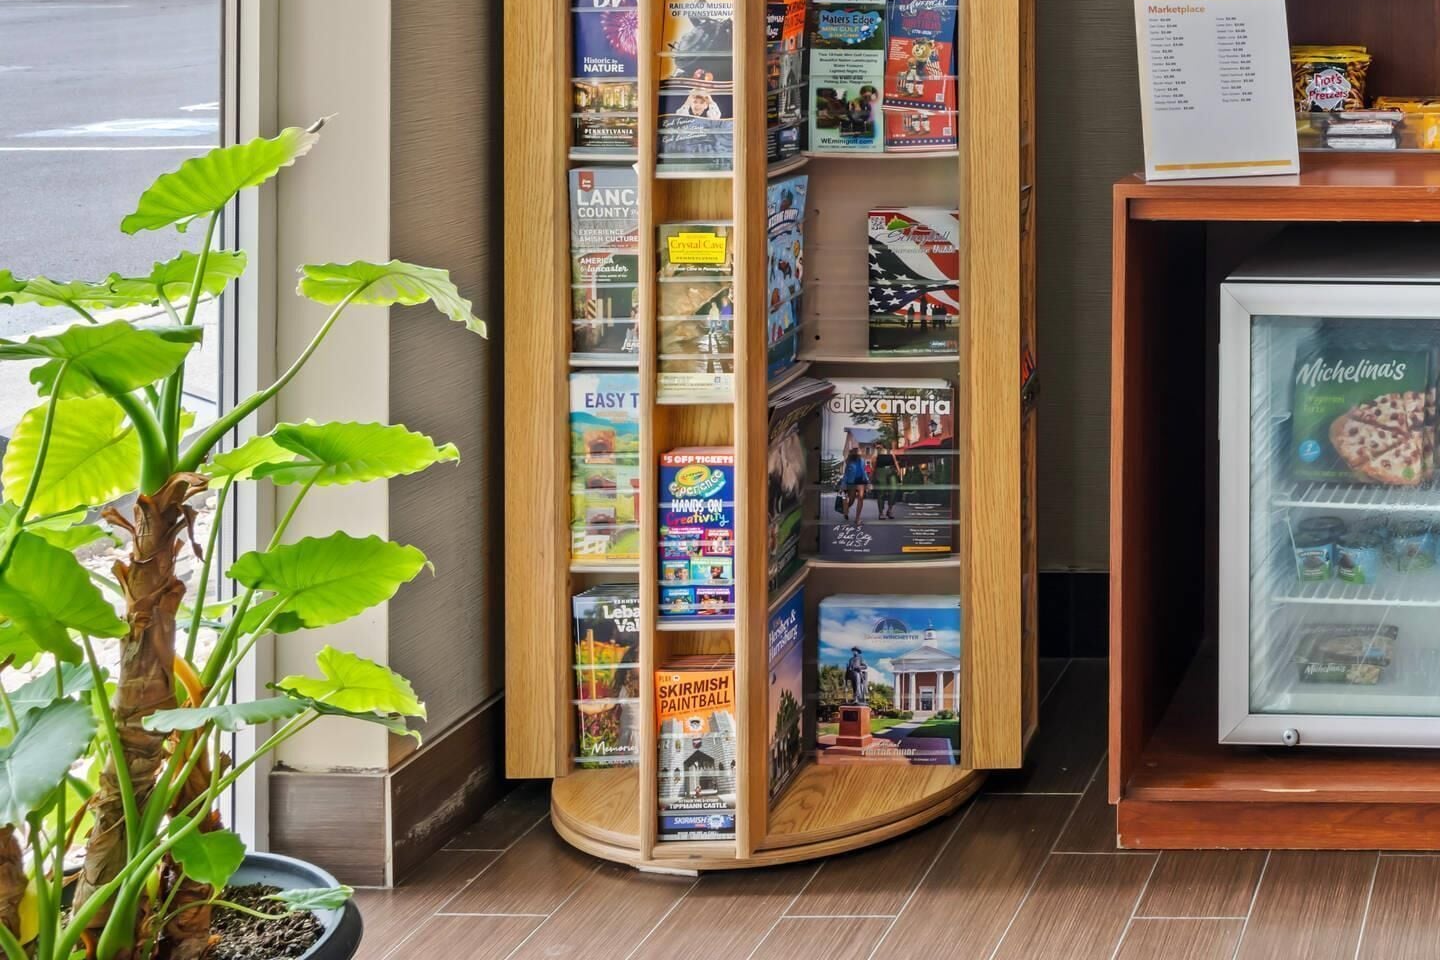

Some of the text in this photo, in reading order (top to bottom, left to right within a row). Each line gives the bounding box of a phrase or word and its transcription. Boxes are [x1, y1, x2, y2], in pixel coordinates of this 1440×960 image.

[1148, 5, 1205, 15] Marketplace
[852, 16, 875, 25] Edge
[584, 64, 624, 73] NATURE
[1309, 90, 1349, 100] Pretzels
[578, 208, 630, 217] COUNTY
[671, 240, 723, 250] Crystal Cave
[1296, 358, 1406, 387] Michelina's
[585, 393, 624, 408] EASY
[830, 394, 950, 415] alexandria
[666, 512, 729, 527] Creativity
[856, 532, 872, 545] City
[790, 608, 796, 623] &
[1303, 663, 1347, 676] Michelina's
[659, 675, 729, 699] SKIRMISH
[660, 694, 731, 714] PAINTBALL
